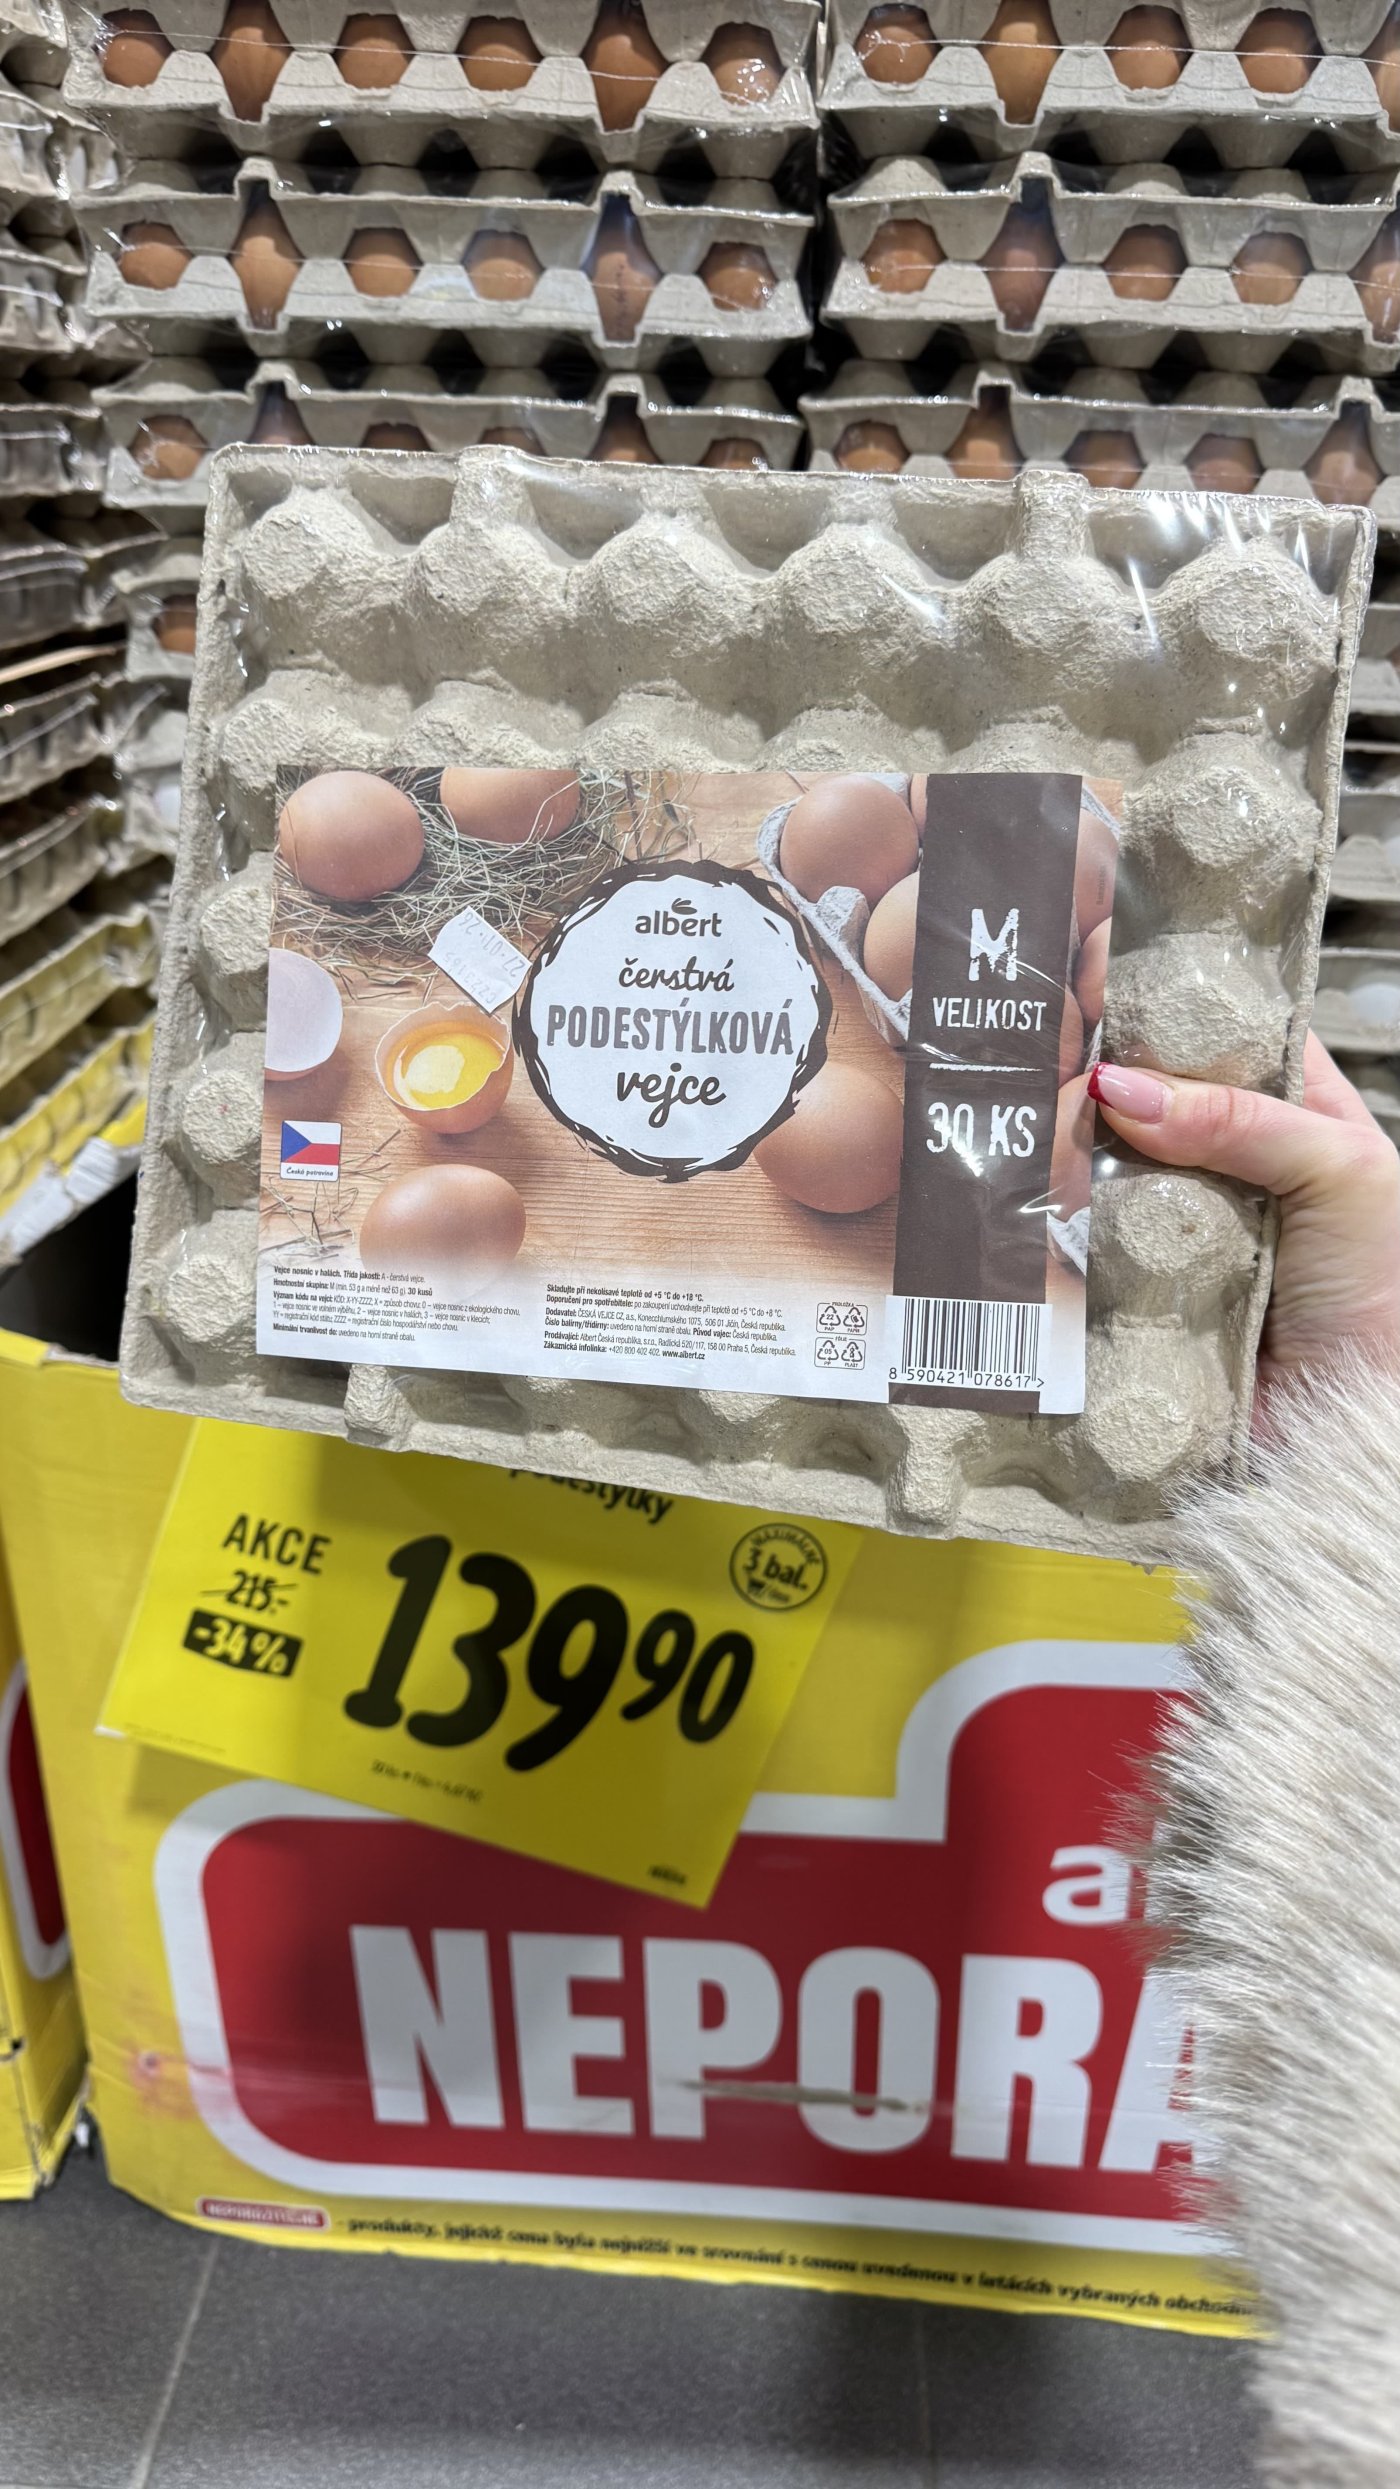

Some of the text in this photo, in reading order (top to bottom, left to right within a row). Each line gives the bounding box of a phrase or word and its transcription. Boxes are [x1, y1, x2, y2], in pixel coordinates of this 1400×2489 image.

[635, 909, 722, 937] albert
[968, 908, 1019, 982] M
[618, 955, 735, 992] čerstvá
[546, 997, 794, 1055] PODESTÝLKOVÁ
[932, 997, 1047, 1031] VELIKOST
[616, 1062, 727, 1129] vejce
[926, 1102, 1037, 1158] 30 KS
[286, 1166, 305, 1175] Česká
[274, 1266, 425, 1284] Vejce nosnic halách. Třída jakosti: čerstvá vejce.
[418, 1288, 432, 1296] kusů
[547, 1284, 575, 1295] Skladujte
[587, 1286, 619, 1296] nekolísavé
[621, 1289, 642, 1300] teplotě
[682, 1293, 693, 1301] +18
[693, 1329, 711, 1337] Původ
[713, 1330, 731, 1340] vajec:
[662, 1350, 705, 1359] www.albert.cz
[889, 1367, 1031, 1389] 8 590421 078617
[221, 1513, 332, 1576] AKCE
[742, 1546, 809, 1591] 3 bal.
[194, 1616, 289, 1674] -34%
